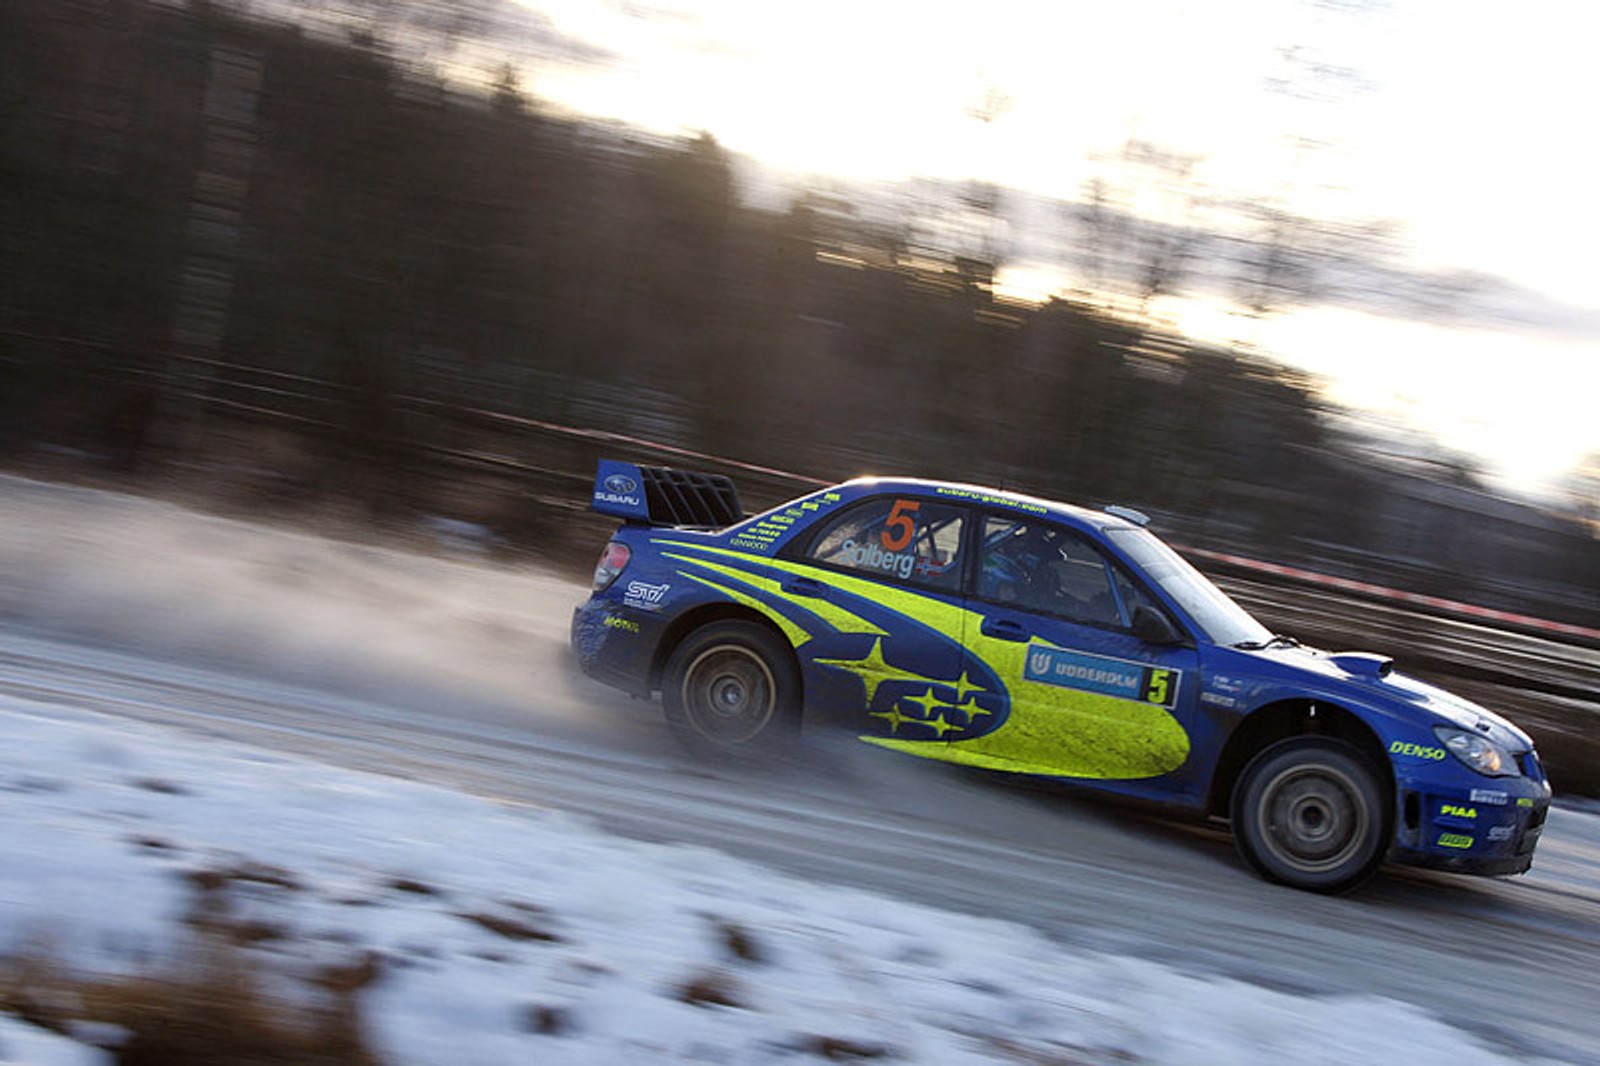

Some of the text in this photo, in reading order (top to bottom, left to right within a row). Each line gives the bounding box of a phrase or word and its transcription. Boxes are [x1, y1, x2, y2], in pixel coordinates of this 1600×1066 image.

[594, 491, 640, 506] SUBARU
[881, 499, 920, 552] 5
[841, 539, 915, 580] Solberg
[1055, 662, 1139, 689] UDDEHOLM
[1147, 669, 1169, 704] 5
[1389, 741, 1446, 762] DENSO
[1440, 804, 1478, 819] PIAA
